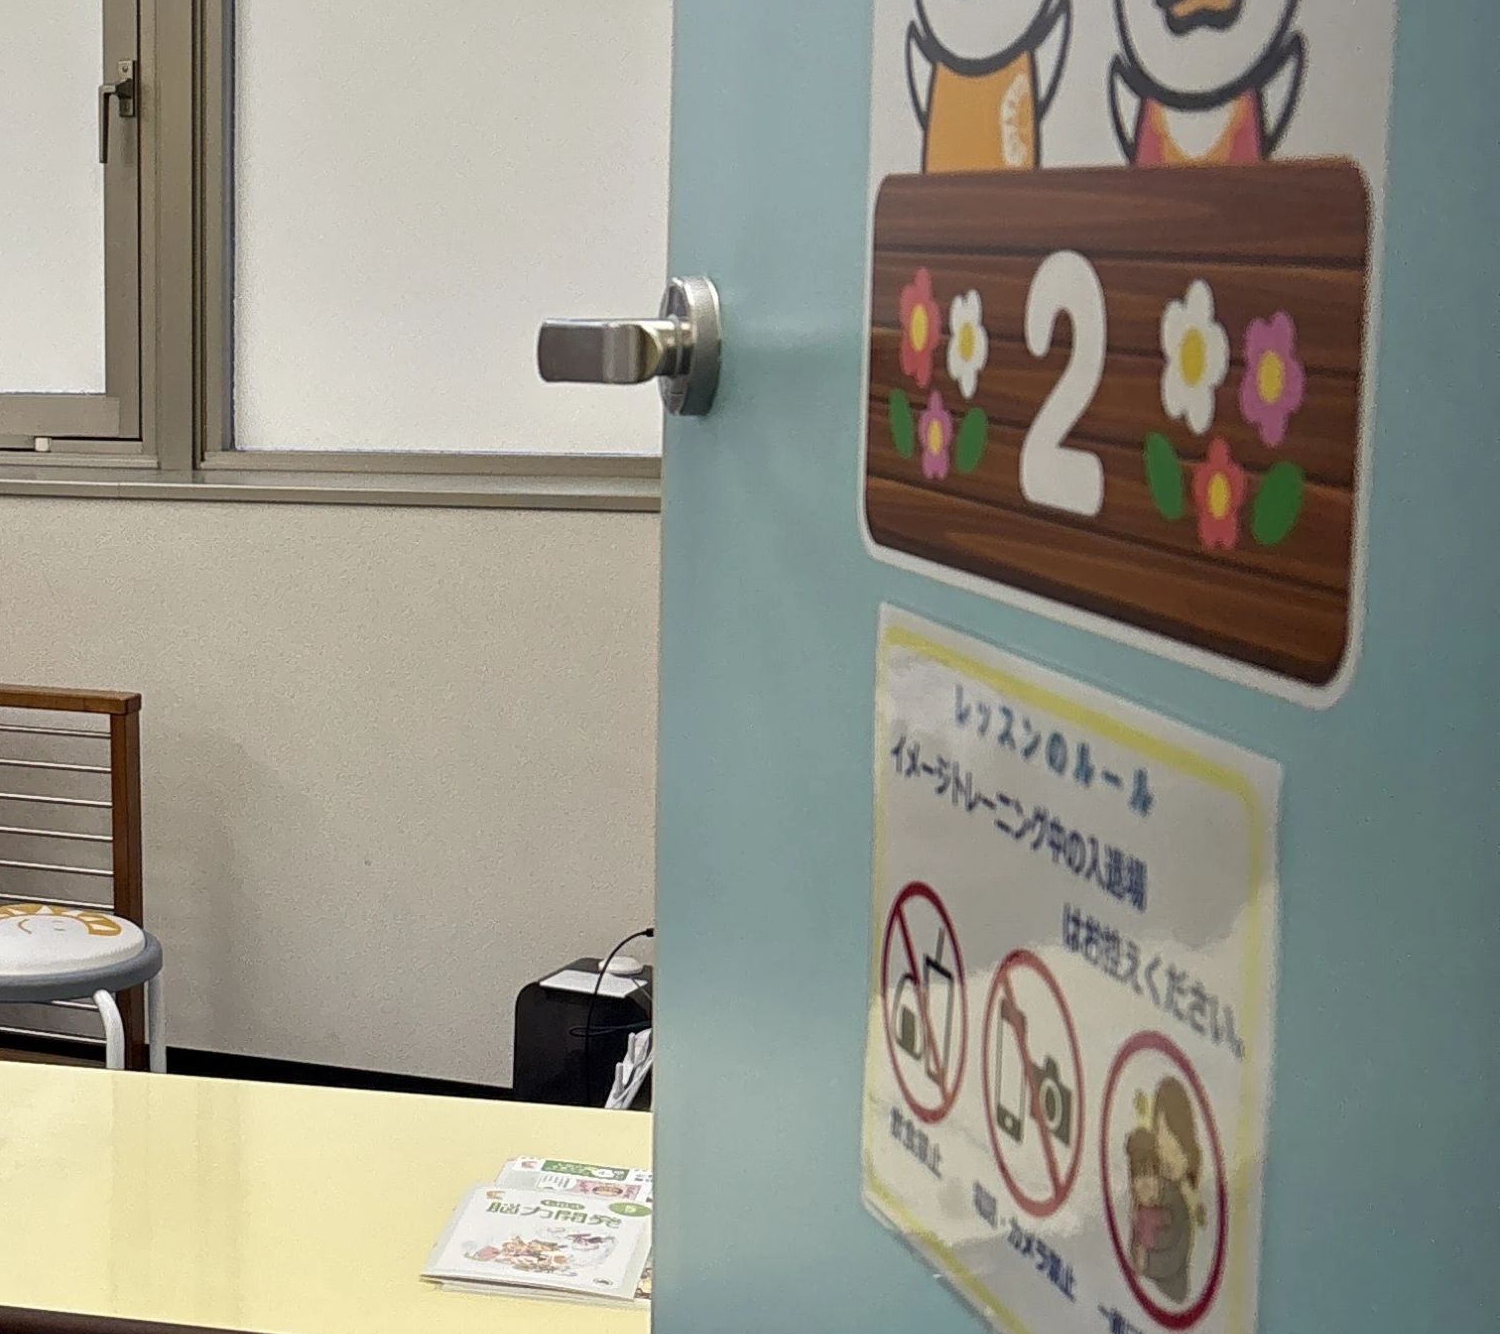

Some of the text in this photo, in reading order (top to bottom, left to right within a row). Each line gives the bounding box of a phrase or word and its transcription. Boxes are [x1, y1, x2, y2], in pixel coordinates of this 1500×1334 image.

[1020, 250, 1107, 516] 2
[891, 737, 1148, 912] イメージトレーニング中の入退場
[954, 685, 1153, 817] レッスンのルール
